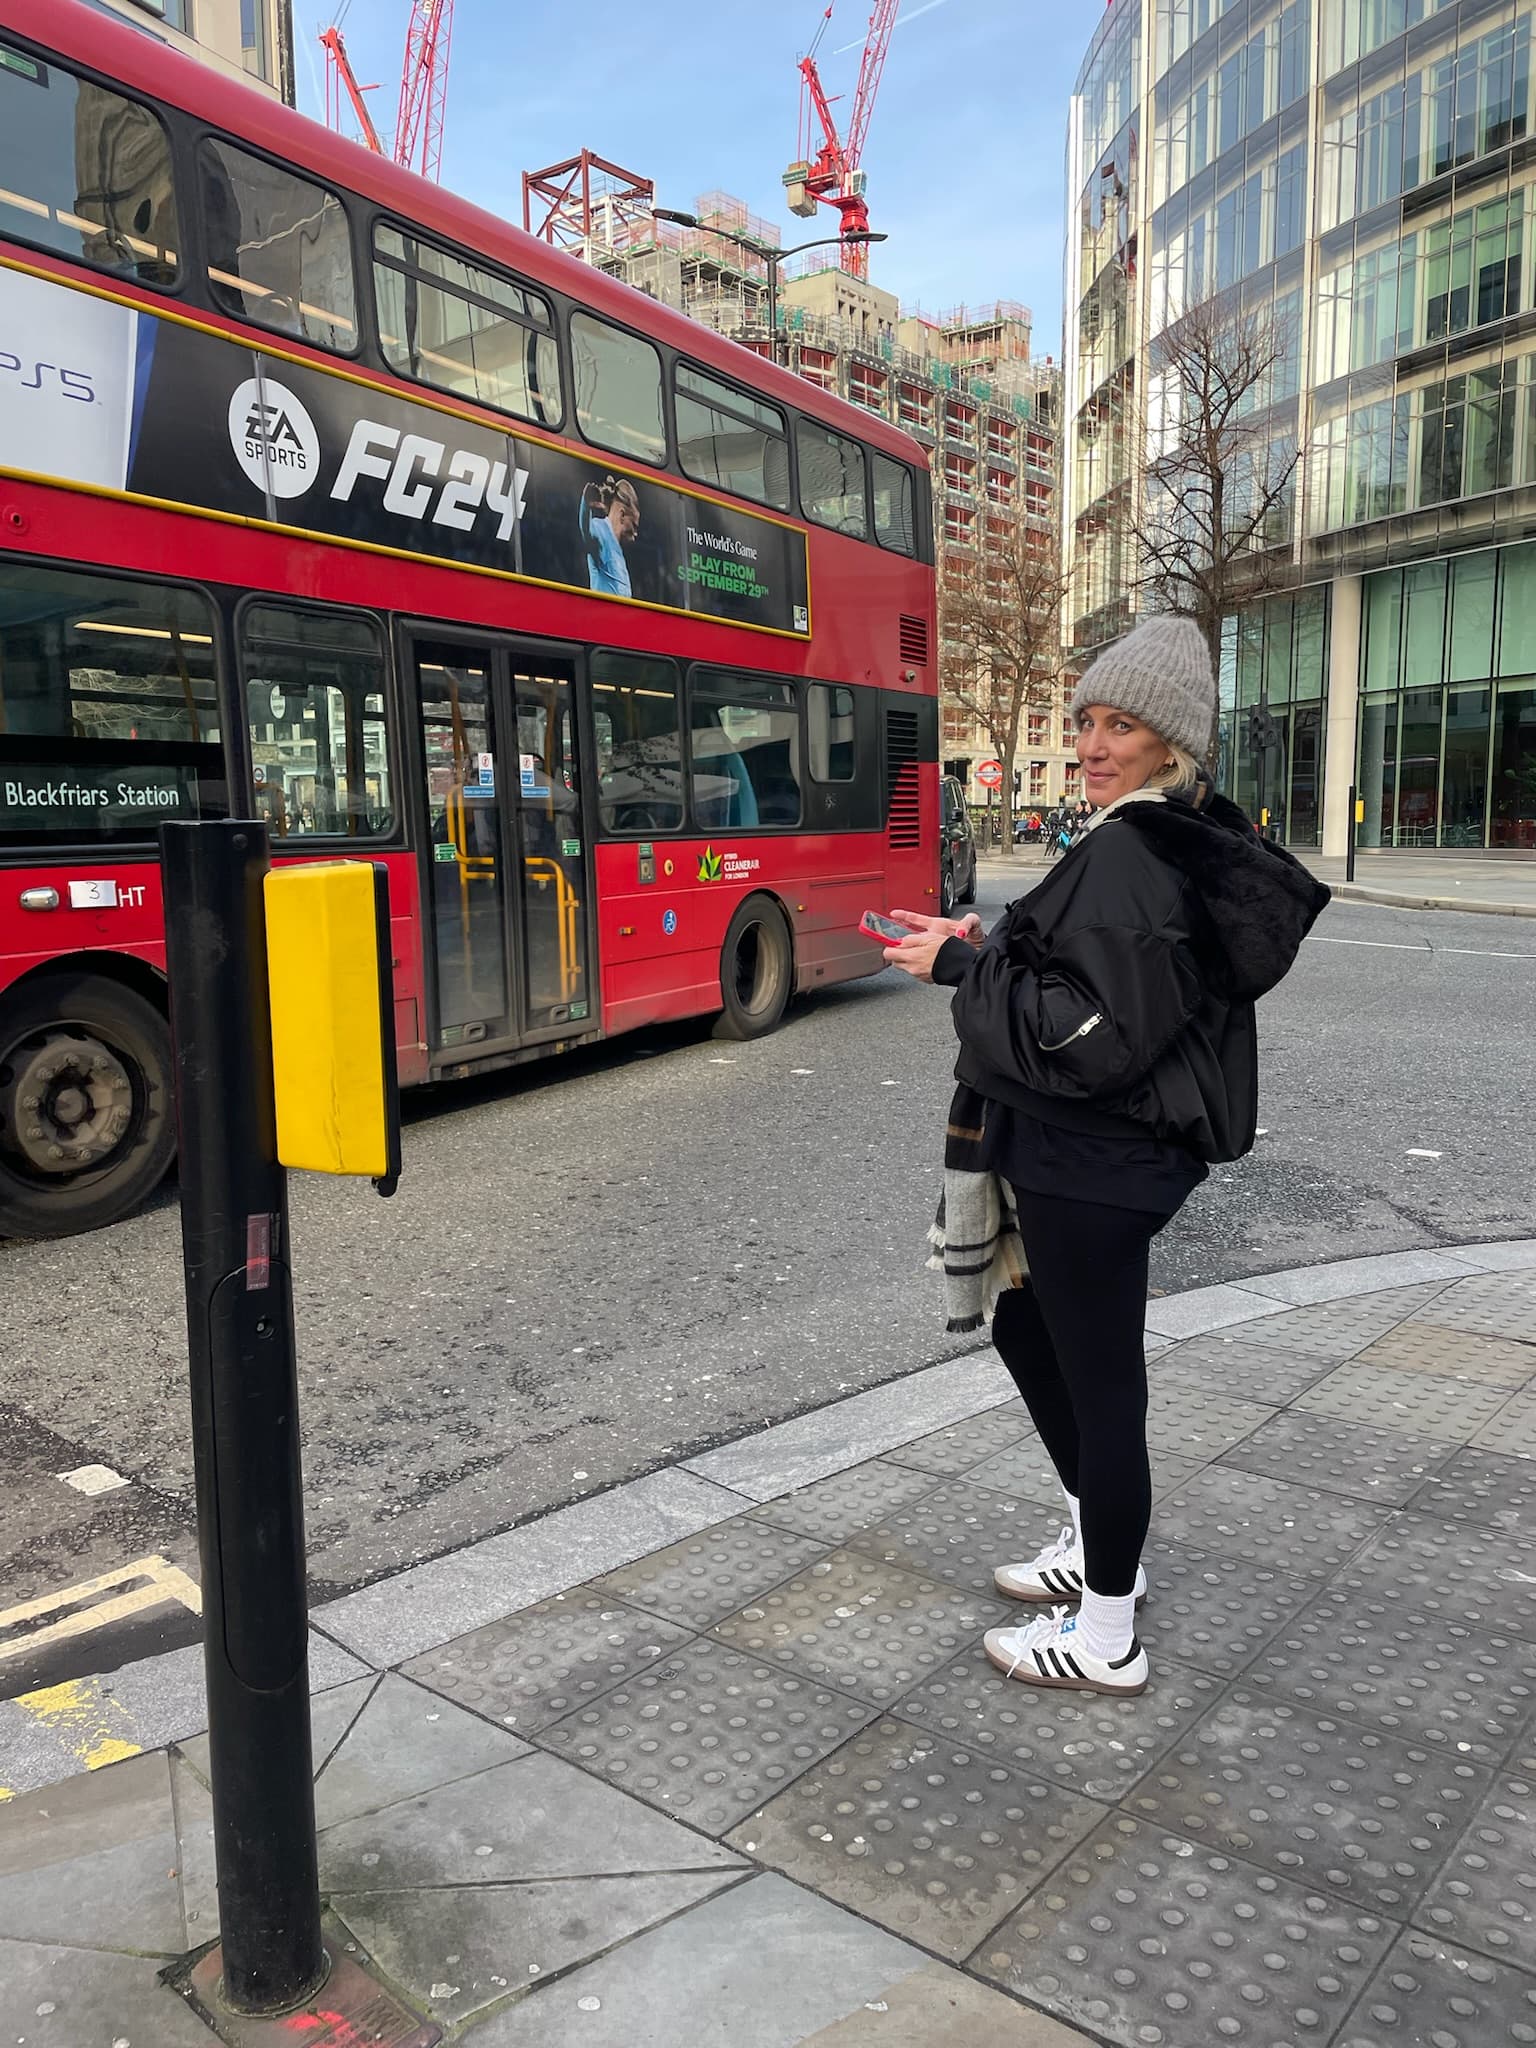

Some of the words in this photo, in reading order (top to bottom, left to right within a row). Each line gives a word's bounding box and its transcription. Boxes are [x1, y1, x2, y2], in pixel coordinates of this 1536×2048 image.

[246, 403, 304, 450] EA
[245, 441, 306, 470] SPORTS
[687, 527, 703, 545] The
[703, 532, 735, 553] World's
[735, 541, 757, 560] Game
[677, 565, 747, 595] SEPTEMBER
[691, 553, 721, 573] PLAY
[723, 561, 756, 582] FROM
[5, 782, 109, 806] Blackfriars
[117, 783, 180, 806] Station
[86, 881, 100, 899] 3
[118, 886, 146, 908] HT
